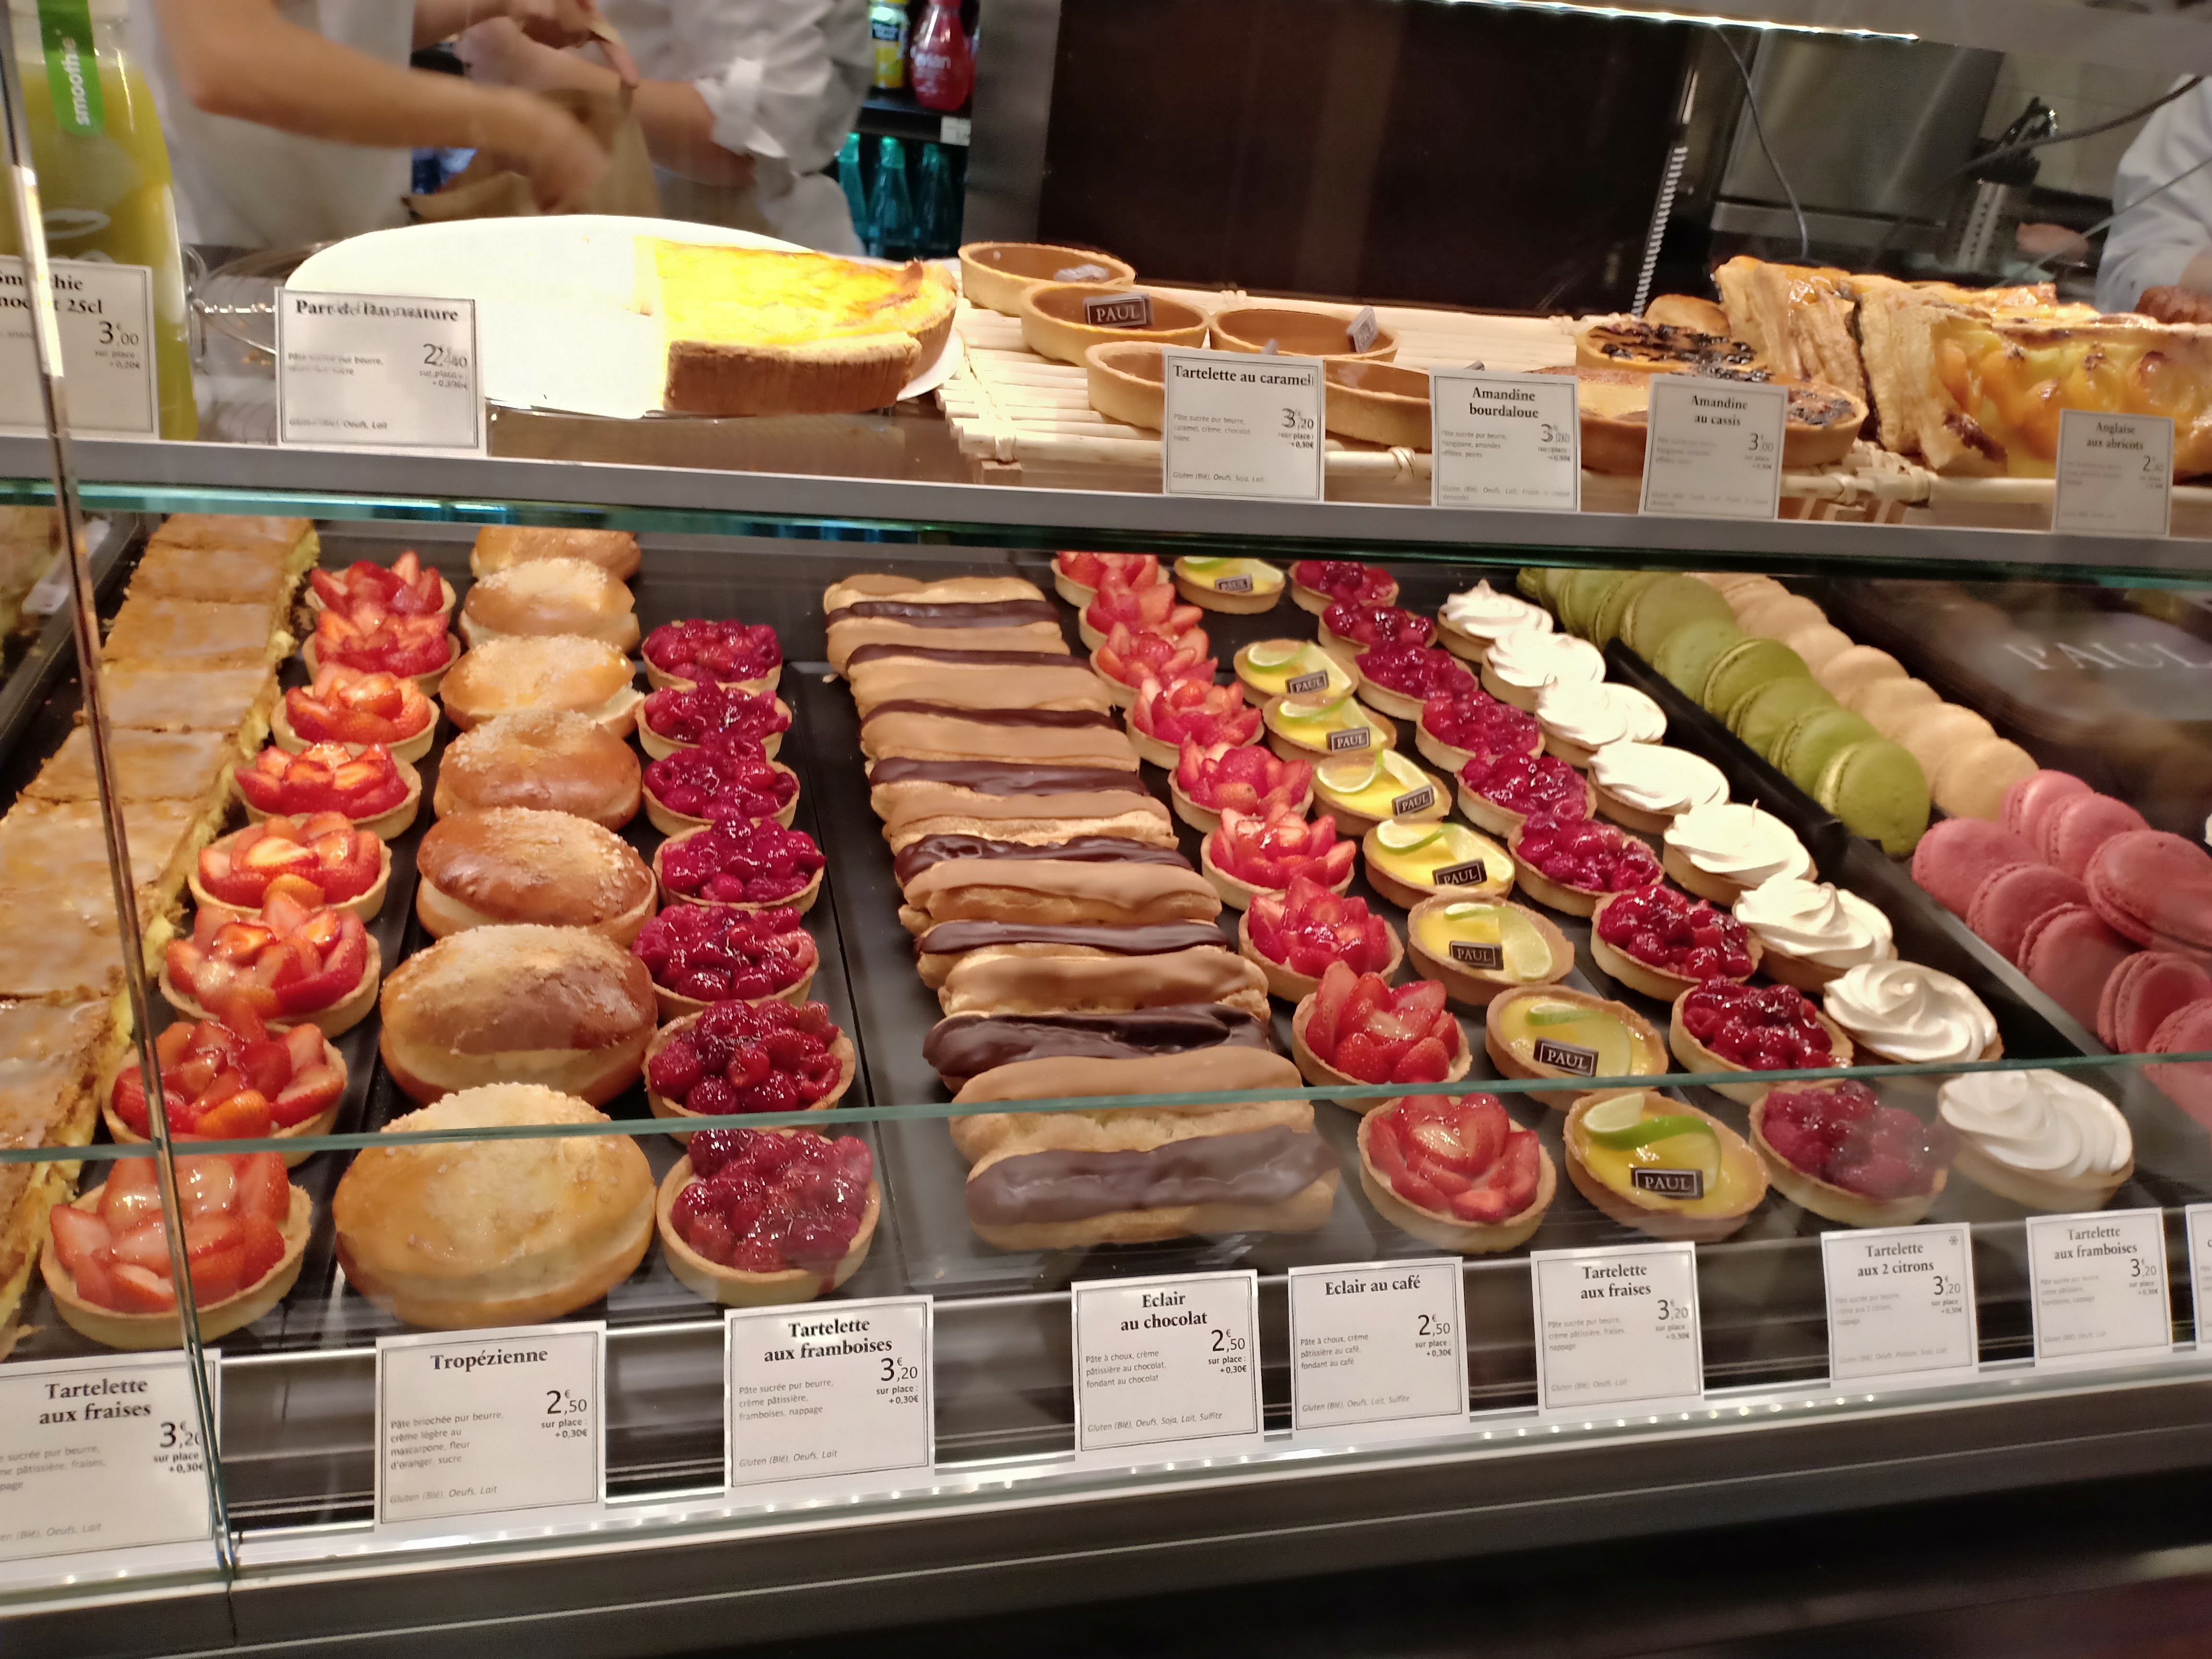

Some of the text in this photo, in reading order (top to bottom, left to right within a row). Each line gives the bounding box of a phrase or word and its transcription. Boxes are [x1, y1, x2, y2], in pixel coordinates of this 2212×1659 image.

[67, 299, 103, 314] 25cl
[1096, 304, 1141, 322] PAUL
[1173, 365, 1237, 381] Tartelette
[1240, 373, 1256, 383] au
[1473, 387, 1536, 401] Amandine
[1691, 394, 1748, 410] Amandine
[1174, 413, 1188, 421] Pâte
[1469, 403, 1539, 418] bourdaloue
[1695, 414, 1741, 426] au cassis
[1296, 679, 1321, 692] PAUL
[1337, 735, 1363, 748] PAUL
[1402, 793, 1429, 811] PAUL
[1443, 869, 1477, 885] PAUL
[1457, 948, 1491, 961] PAUL
[1547, 1049, 1587, 1069] PAUL
[1645, 1176, 1690, 1190] PAUL
[2067, 1226, 2120, 1241] Tartelette
[1865, 1242, 1923, 1257] Tartelette
[2055, 1242, 2138, 1260] aux framboises
[1582, 1263, 1647, 1280] Tartelette
[1858, 1261, 1935, 1277] aux 2 citrons
[1325, 1274, 1421, 1296] Eclair au café
[1581, 1282, 1651, 1299] aux fraises
[1142, 1291, 1186, 1308] Eclair
[788, 1318, 870, 1337] Tartelette
[1121, 1310, 1208, 1331] au chocolat
[1564, 1319, 1584, 1327] sucrée
[1323, 1335, 1346, 1344] choux,
[1348, 1333, 1369, 1341] crème
[764, 1337, 892, 1362] aux framboises
[1111, 1352, 1135, 1360] choux,
[1137, 1350, 1159, 1358] crème
[1301, 1348, 1333, 1358] pâtissière
[431, 1349, 548, 1372] Tropézienne
[1301, 1360, 1327, 1370] fondant
[1086, 1366, 1120, 1377] pâtissière
[1134, 1361, 1166, 1370] chocolat,
[45, 1378, 148, 1399] Tartelette
[739, 1379, 834, 1395] Pâte sucrée pur beurre,
[1087, 1378, 1115, 1388] fondant
[1129, 1374, 1159, 1383] chocolat
[1551, 1383, 1572, 1392] Gluten
[739, 1395, 808, 1407] crème pâtissière,
[1302, 1403, 1325, 1412] Gluten
[1388, 1395, 1410, 1404] Sulfite
[39, 1401, 151, 1424] aux fraises
[739, 1406, 823, 1421] framboises, nappage
[390, 1411, 504, 1430] Pâte briochée pur beurre,
[541, 1421, 555, 1429] sur
[1088, 1423, 1112, 1432] Gluten
[1200, 1411, 1223, 1421] Sulfite
[390, 1432, 418, 1443] crème
[421, 1429, 448, 1440] légère
[8, 1450, 40, 1460] sucrée
[44, 1448, 60, 1459] pur
[65, 1445, 100, 1455] beurre,
[450, 1441, 470, 1449] fleur
[153, 1452, 199, 1463] sur place
[438, 1455, 462, 1464] sucre
[739, 1450, 837, 1467] Gluten (Blé), Oeufs, Lait
[390, 1485, 497, 1504] Gluten Lait
